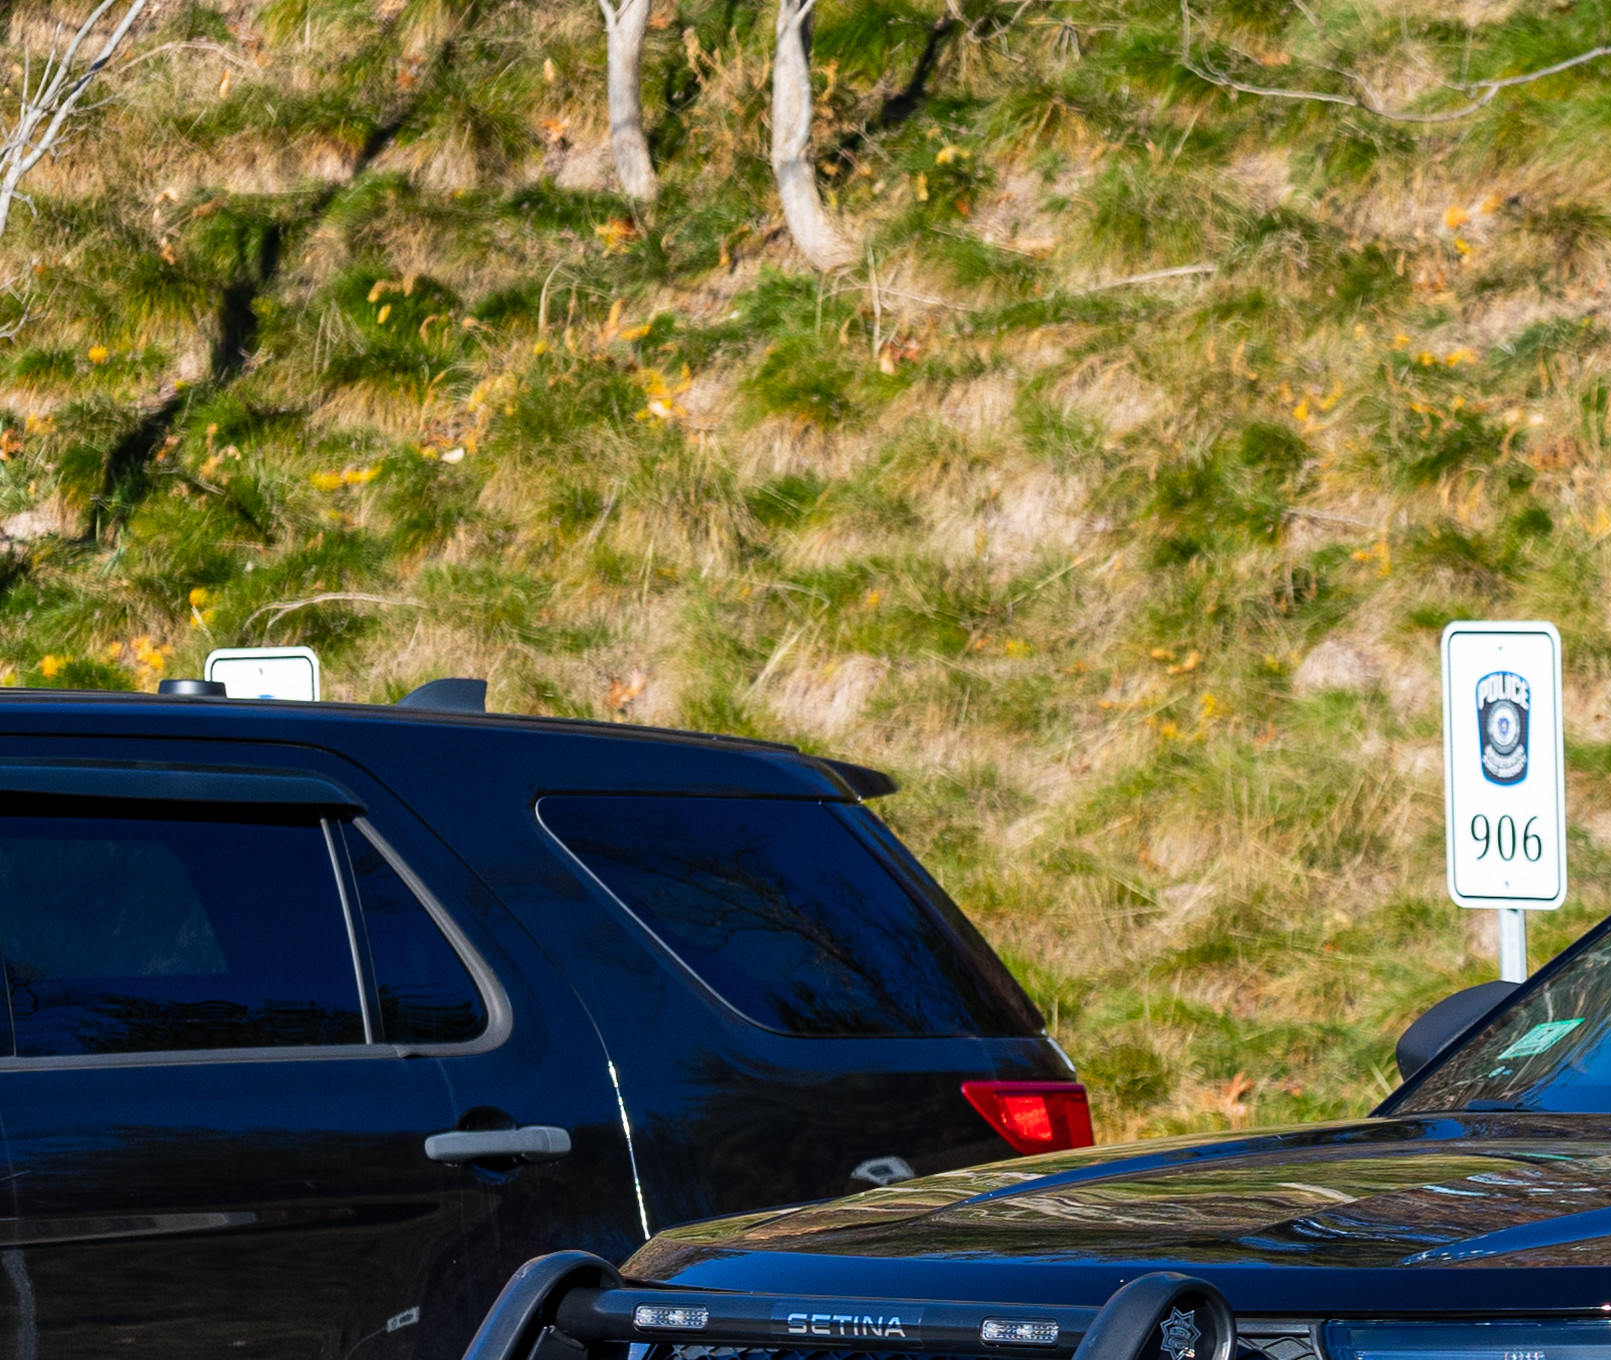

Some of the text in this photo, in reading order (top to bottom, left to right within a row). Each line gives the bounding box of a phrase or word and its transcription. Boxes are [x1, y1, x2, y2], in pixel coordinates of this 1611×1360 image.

[1478, 674, 1530, 710] POLICE
[1471, 814, 1542, 862] 906
[787, 1313, 906, 1338] SETINA
